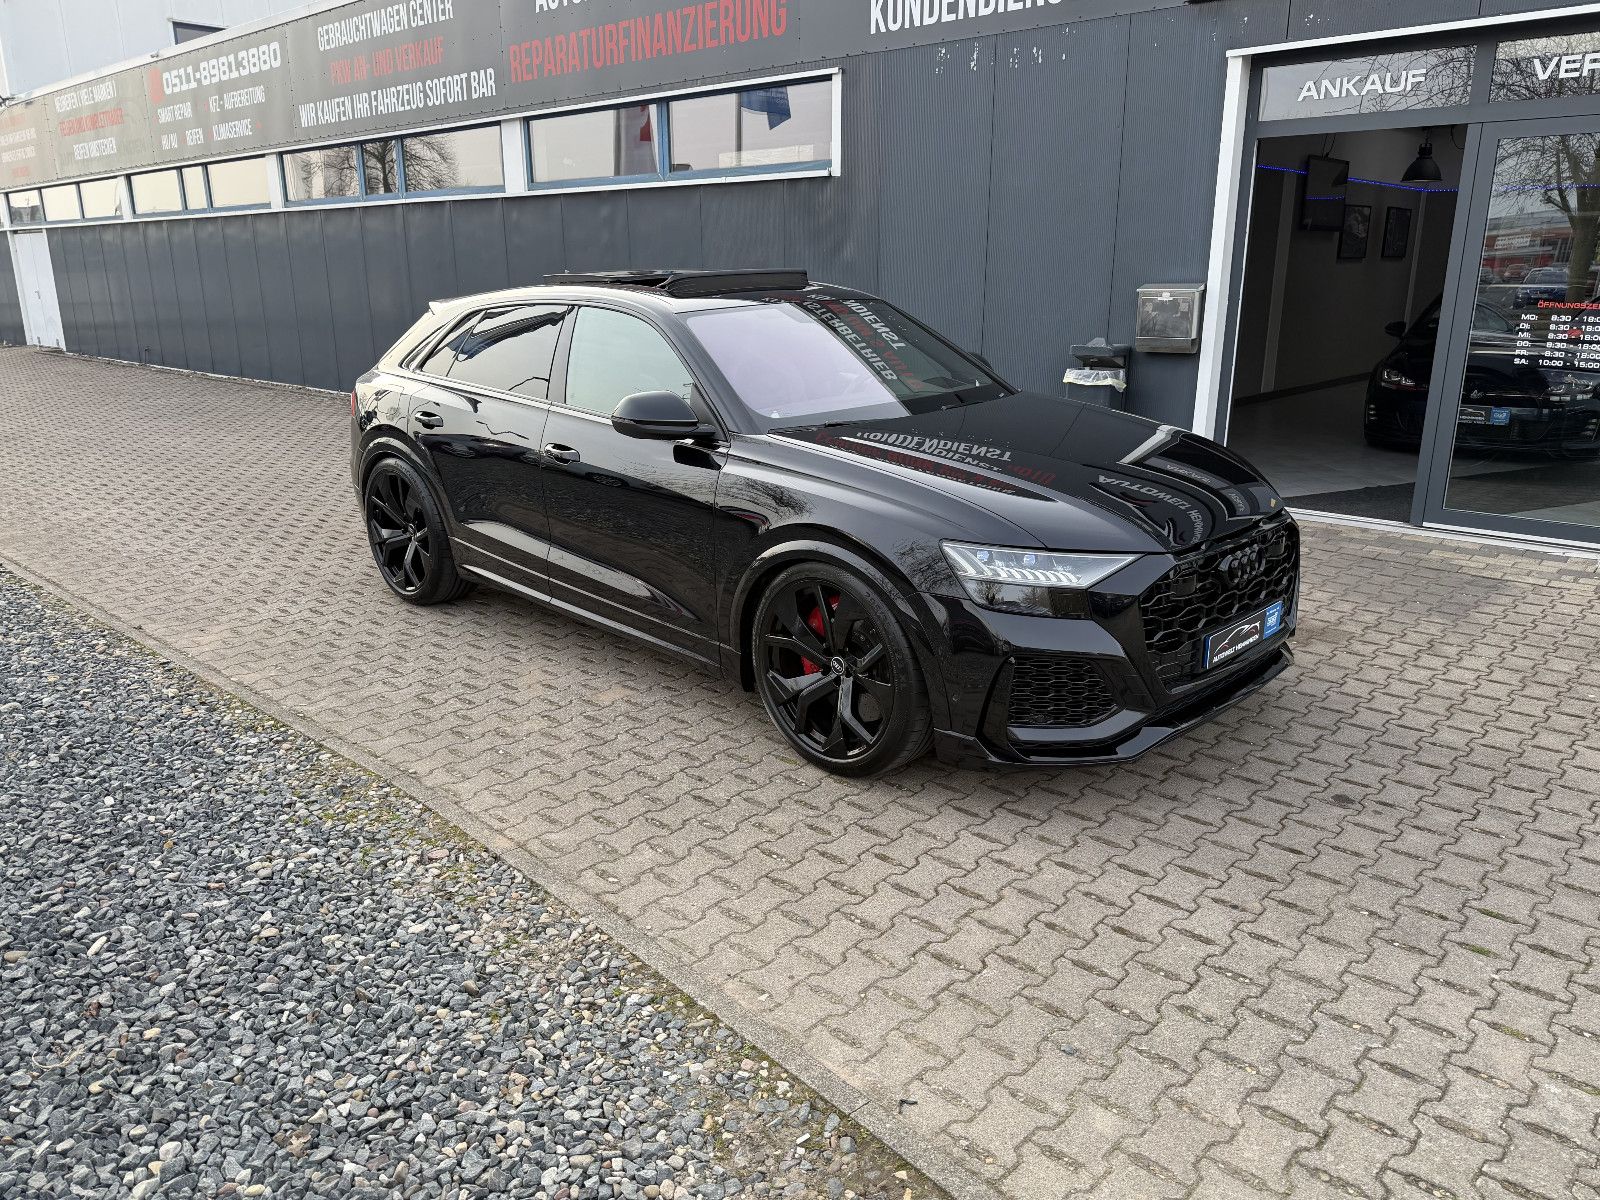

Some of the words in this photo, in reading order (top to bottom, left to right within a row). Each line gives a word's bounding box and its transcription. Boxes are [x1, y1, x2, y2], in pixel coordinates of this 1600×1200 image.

[318, 2, 407, 51] GEBRAUCHTWAGEN
[410, 0, 454, 27] CENTER
[509, 0, 788, 83] REPARATURFINANZIERUNG
[163, 41, 281, 95] 0511-89813880
[371, 48, 394, 78] UND
[395, 35, 445, 73] VERKAUF
[299, 103, 318, 128] WIR
[317, 94, 353, 126] KAUFEN
[353, 91, 371, 118] IHR
[371, 82, 425, 117] FAHRZEUG
[426, 72, 468, 106] SOFORT
[470, 67, 497, 99] BAR
[1297, 68, 1427, 102] ANKAUF
[208, 95, 220, 113] KFZ
[1549, 323, 1570, 331] 8:30
[1551, 314, 1572, 322] 8:30
[1544, 350, 1565, 358] 8:30
[1546, 341, 1567, 349] 8:30
[1538, 359, 1564, 367] 10:00
